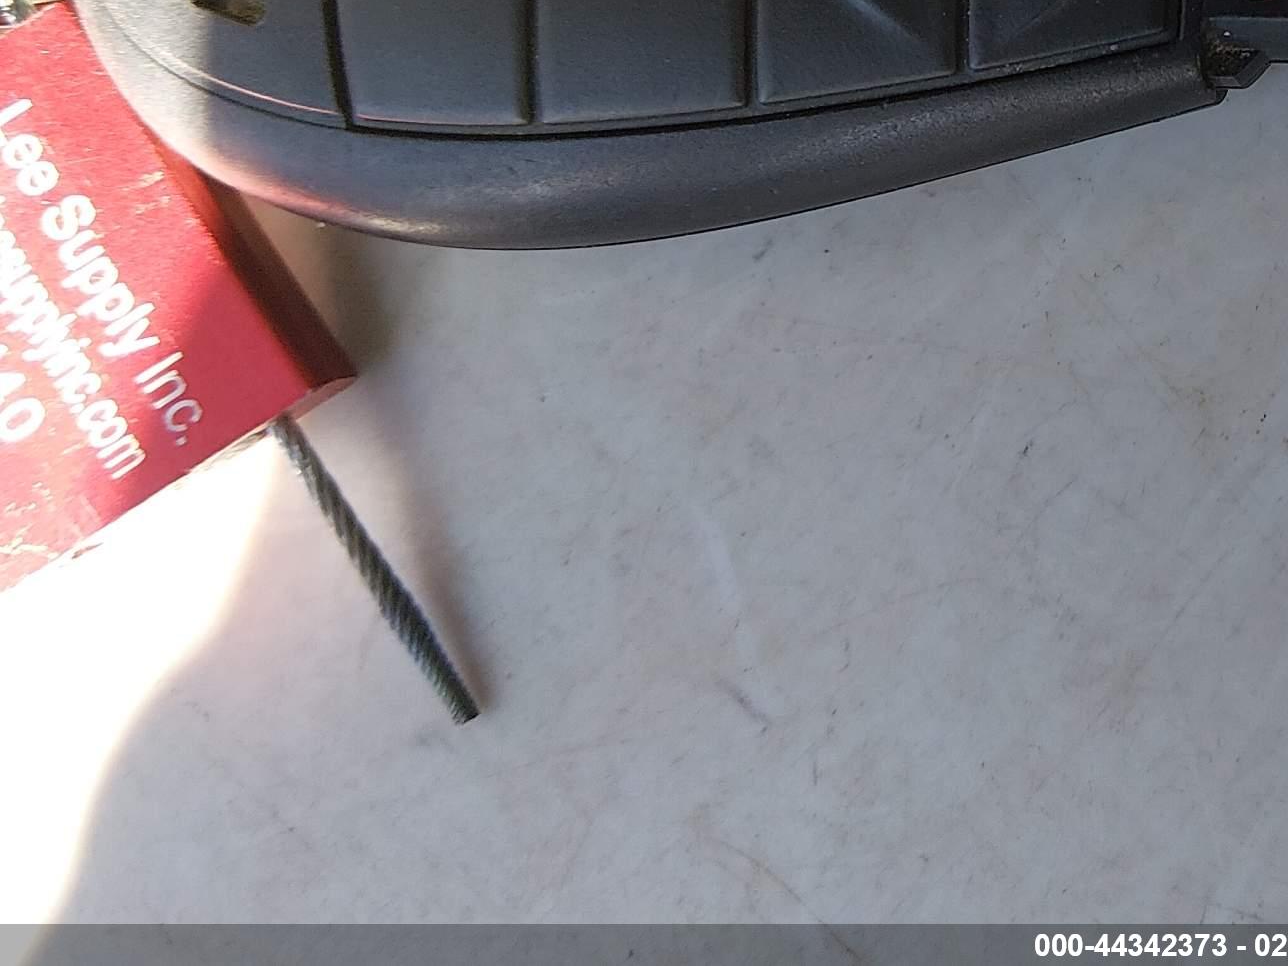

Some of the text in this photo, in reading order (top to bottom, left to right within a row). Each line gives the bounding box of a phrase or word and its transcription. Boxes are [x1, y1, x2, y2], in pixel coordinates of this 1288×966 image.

[0, 97, 203, 447] Lee Supply Inc.
